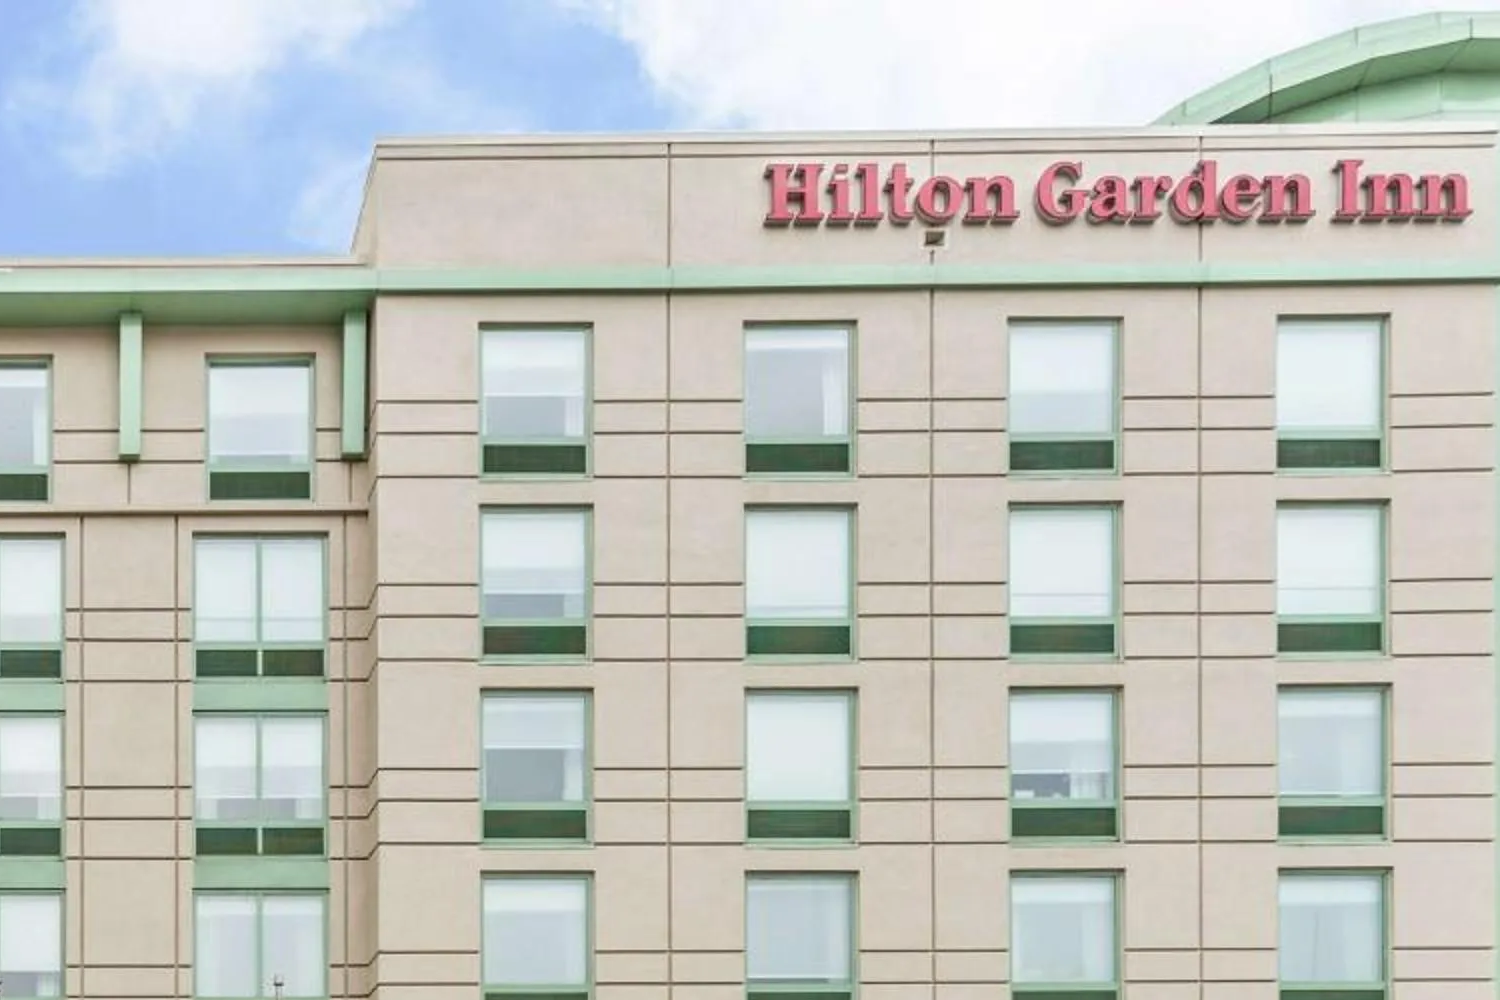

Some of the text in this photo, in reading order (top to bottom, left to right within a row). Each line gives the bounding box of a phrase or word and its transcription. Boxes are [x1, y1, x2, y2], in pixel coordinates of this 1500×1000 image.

[764, 159, 1473, 226] Hilton Garden Inn
